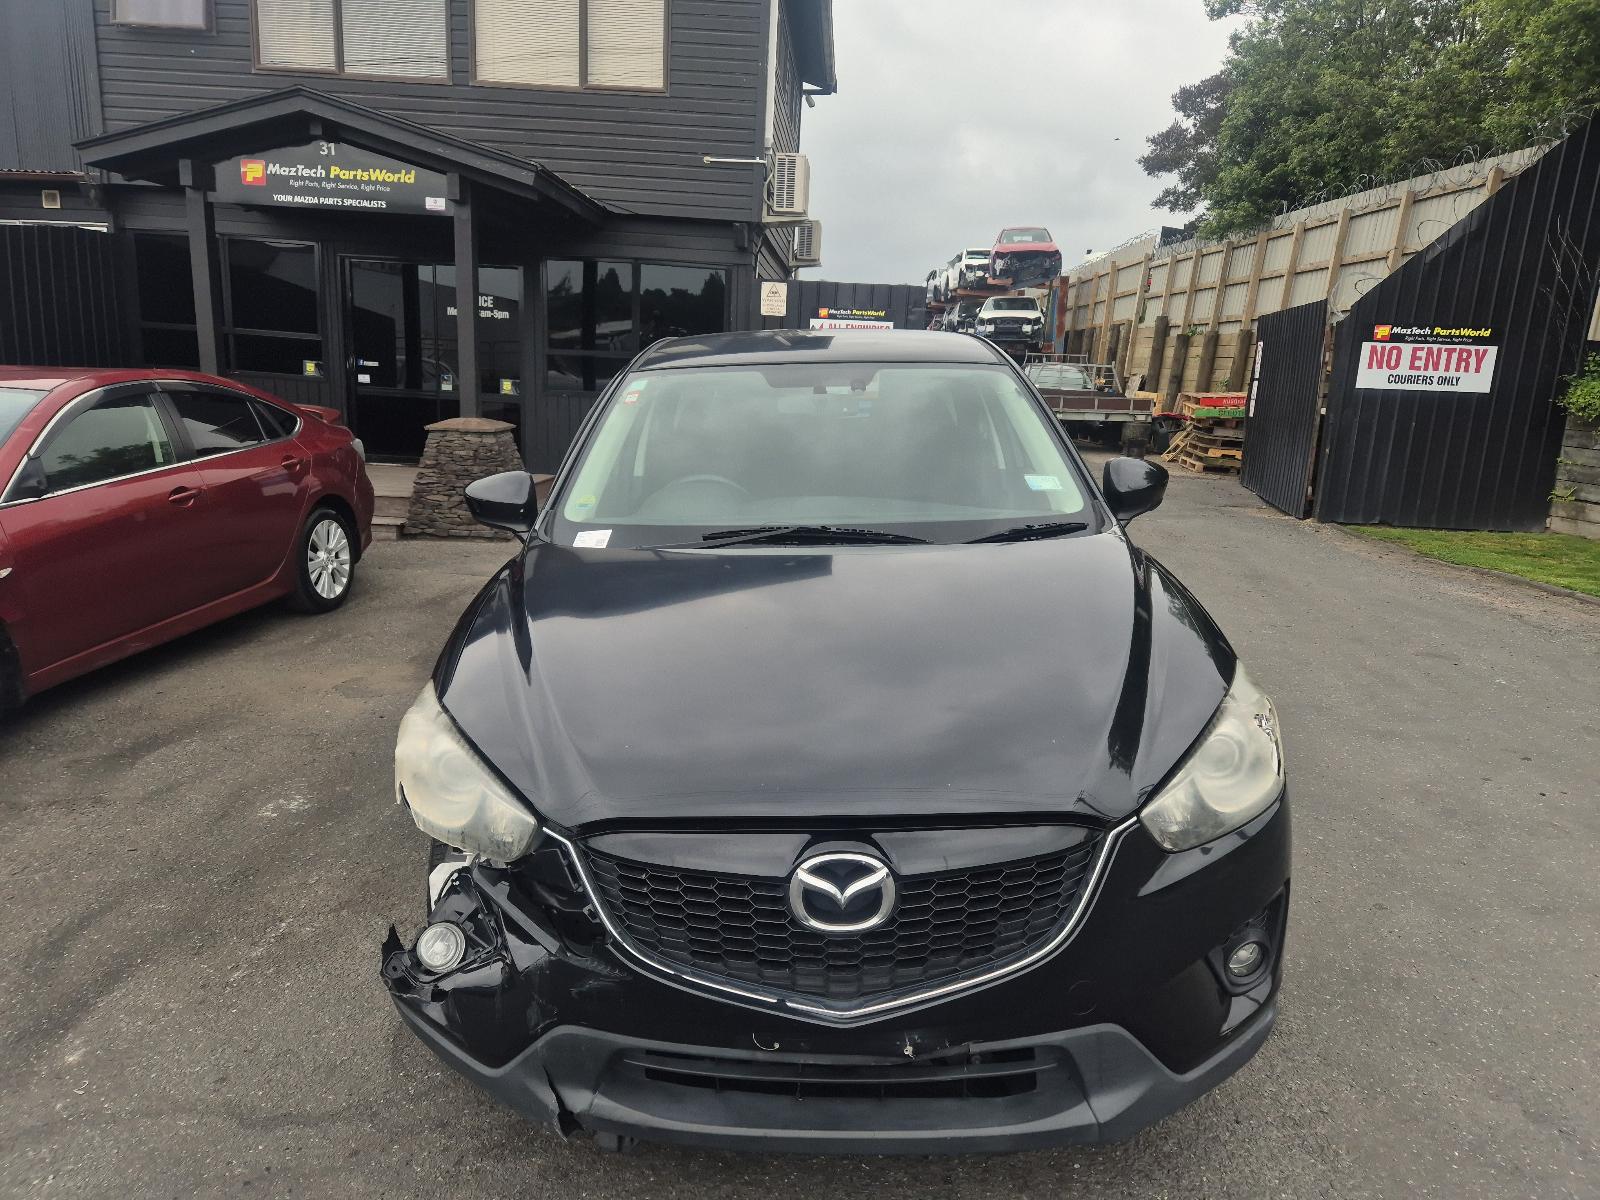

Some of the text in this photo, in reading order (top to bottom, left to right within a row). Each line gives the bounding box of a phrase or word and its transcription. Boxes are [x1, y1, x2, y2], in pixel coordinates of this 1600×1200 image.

[319, 142, 335, 156] 31
[267, 163, 415, 184] MazTech PartsWorld
[289, 179, 304, 188] Right
[321, 181, 336, 190] Right
[360, 183, 375, 192] Right
[376, 184, 390, 192] Price
[273, 194, 387, 208] YOUR MAZDA PARTS SPECIALISTS
[478, 295, 494, 308] ICE
[478, 309, 510, 319] am-5pm
[852, 309, 886, 317] PartsWorld
[1390, 326, 1491, 337] MazTech PartsWorld
[1367, 344, 1488, 373] NO ENTRY
[1387, 374, 1461, 387] COURIERS ONLY
